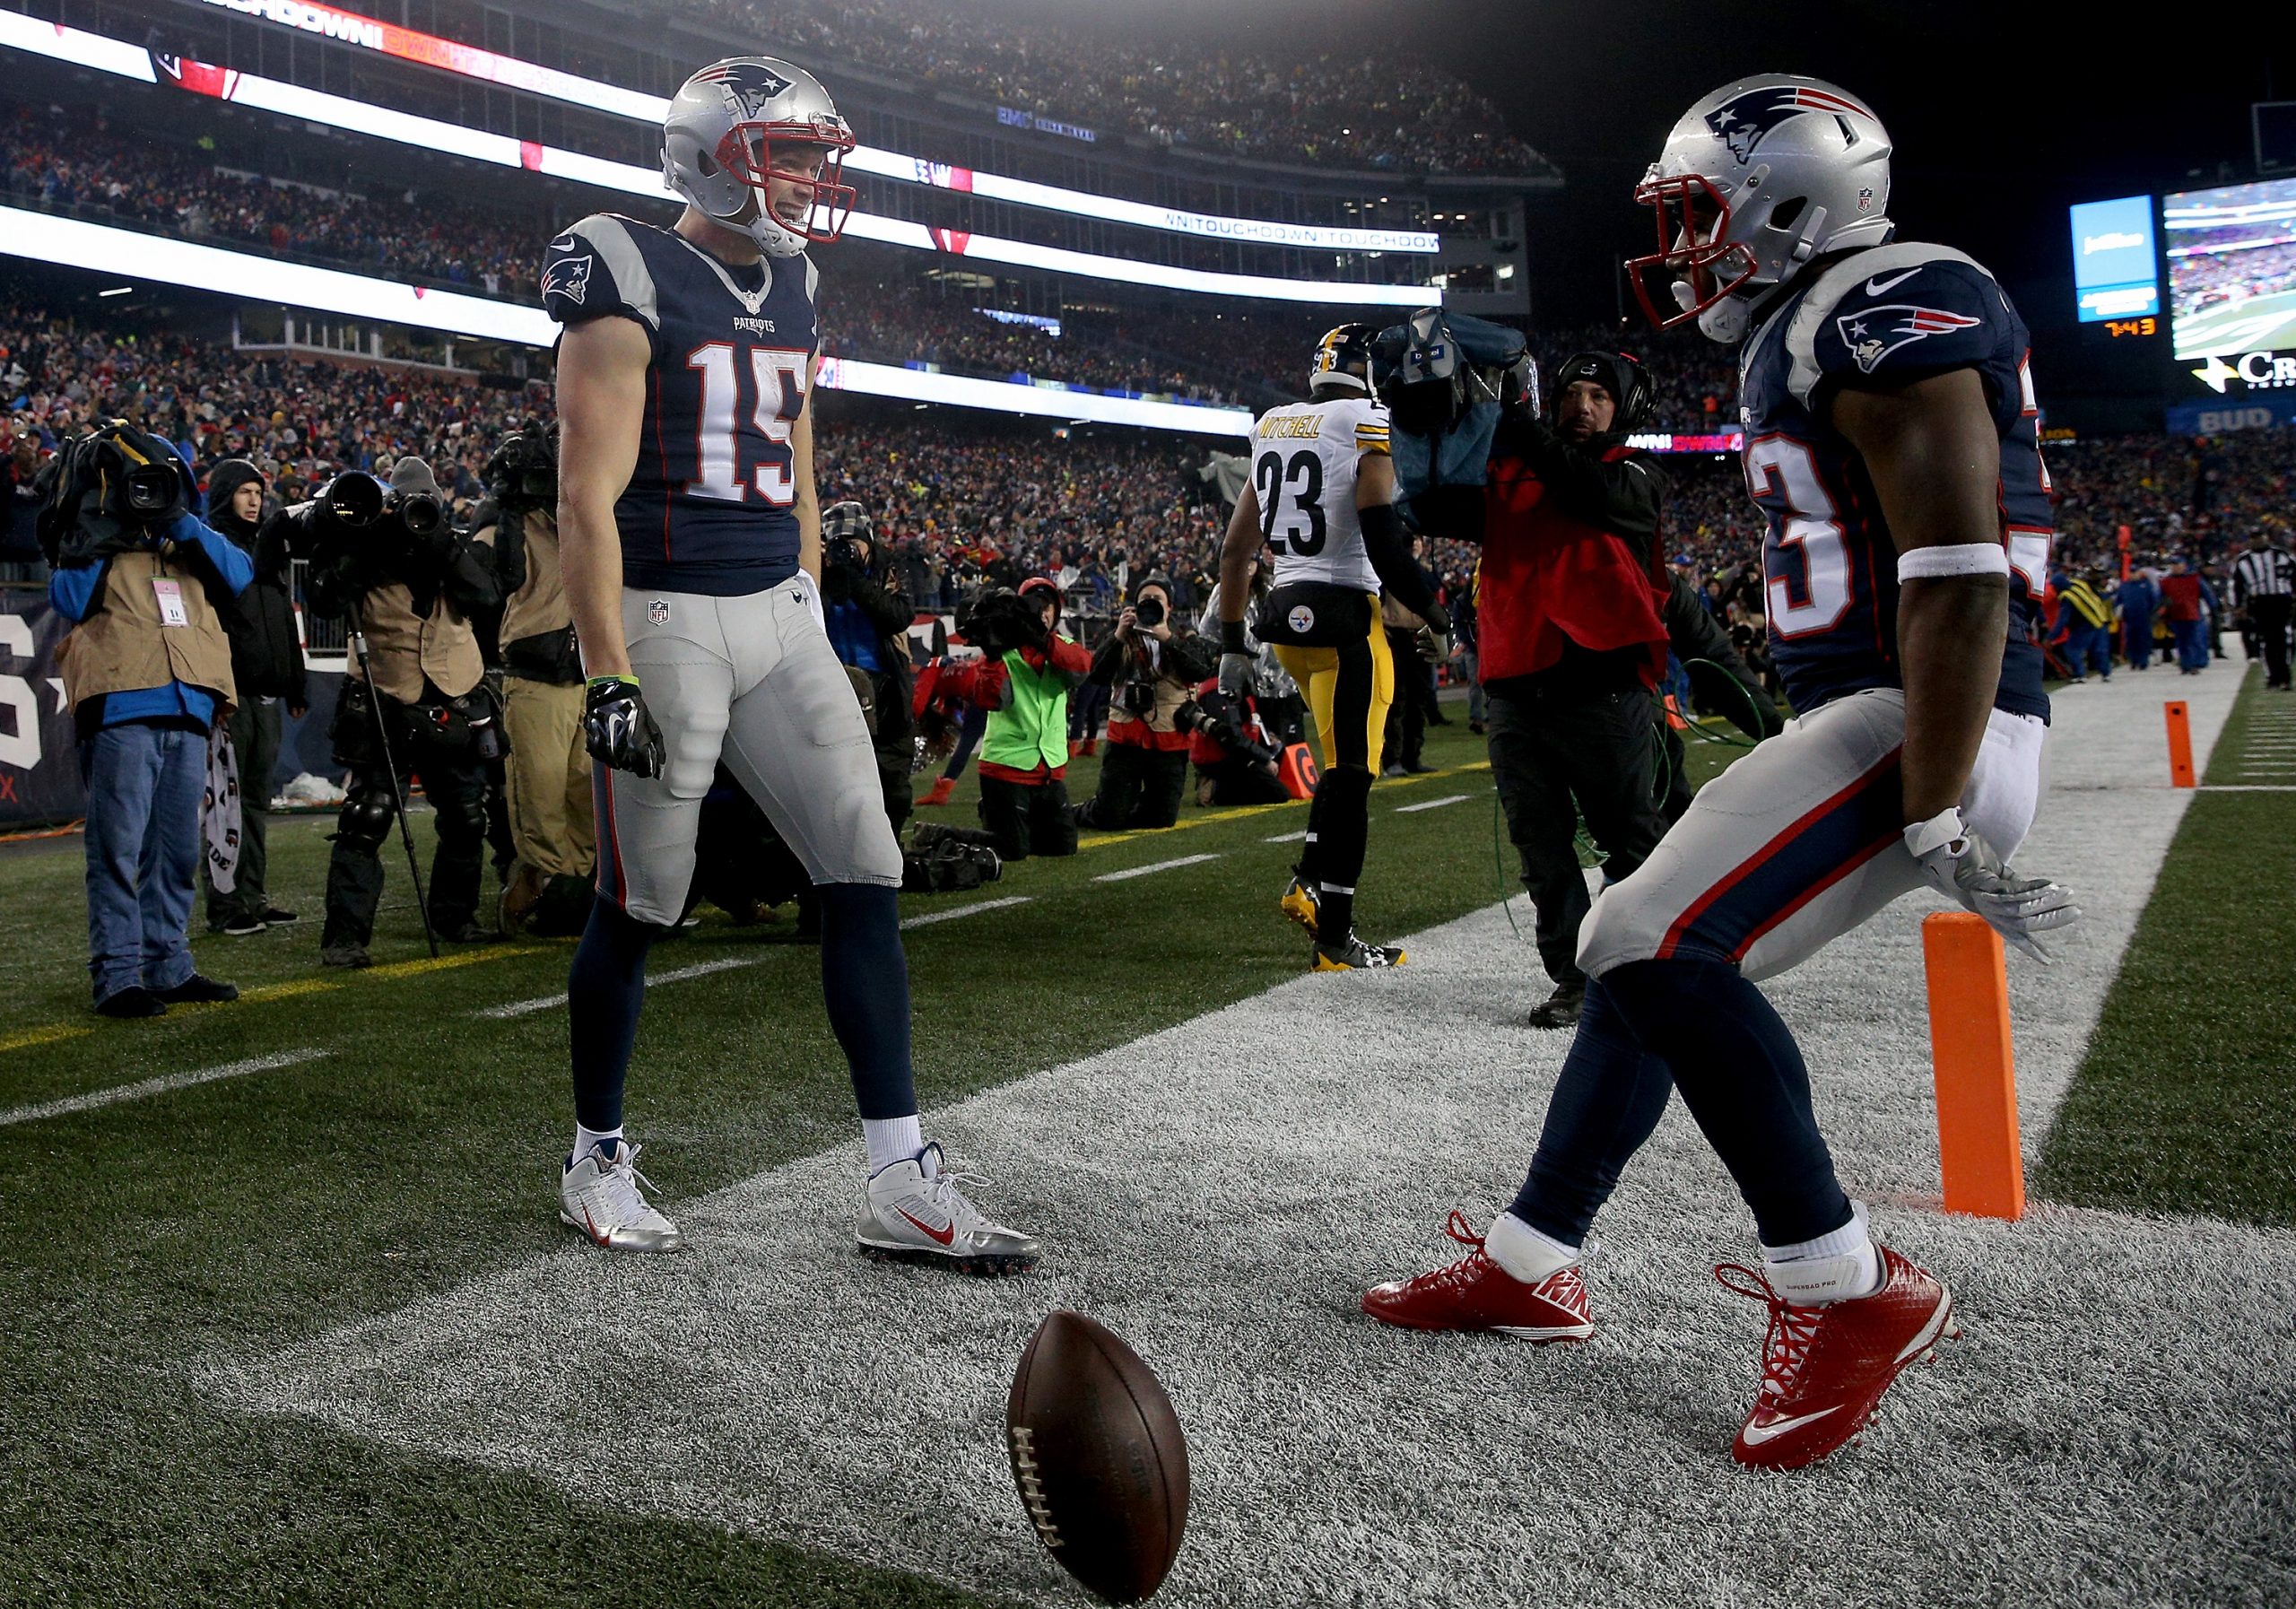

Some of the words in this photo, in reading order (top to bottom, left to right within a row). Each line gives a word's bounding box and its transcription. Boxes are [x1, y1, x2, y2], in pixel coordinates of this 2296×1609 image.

[734, 317, 775, 333] PATRIOTS
[2105, 317, 2156, 337] 7:43
[683, 341, 809, 506] 15
[2198, 407, 2272, 433] BUD
[1257, 449, 1327, 557] 23
[650, 610, 667, 621] NFL
[1822, 1280, 1836, 1288] PRO
